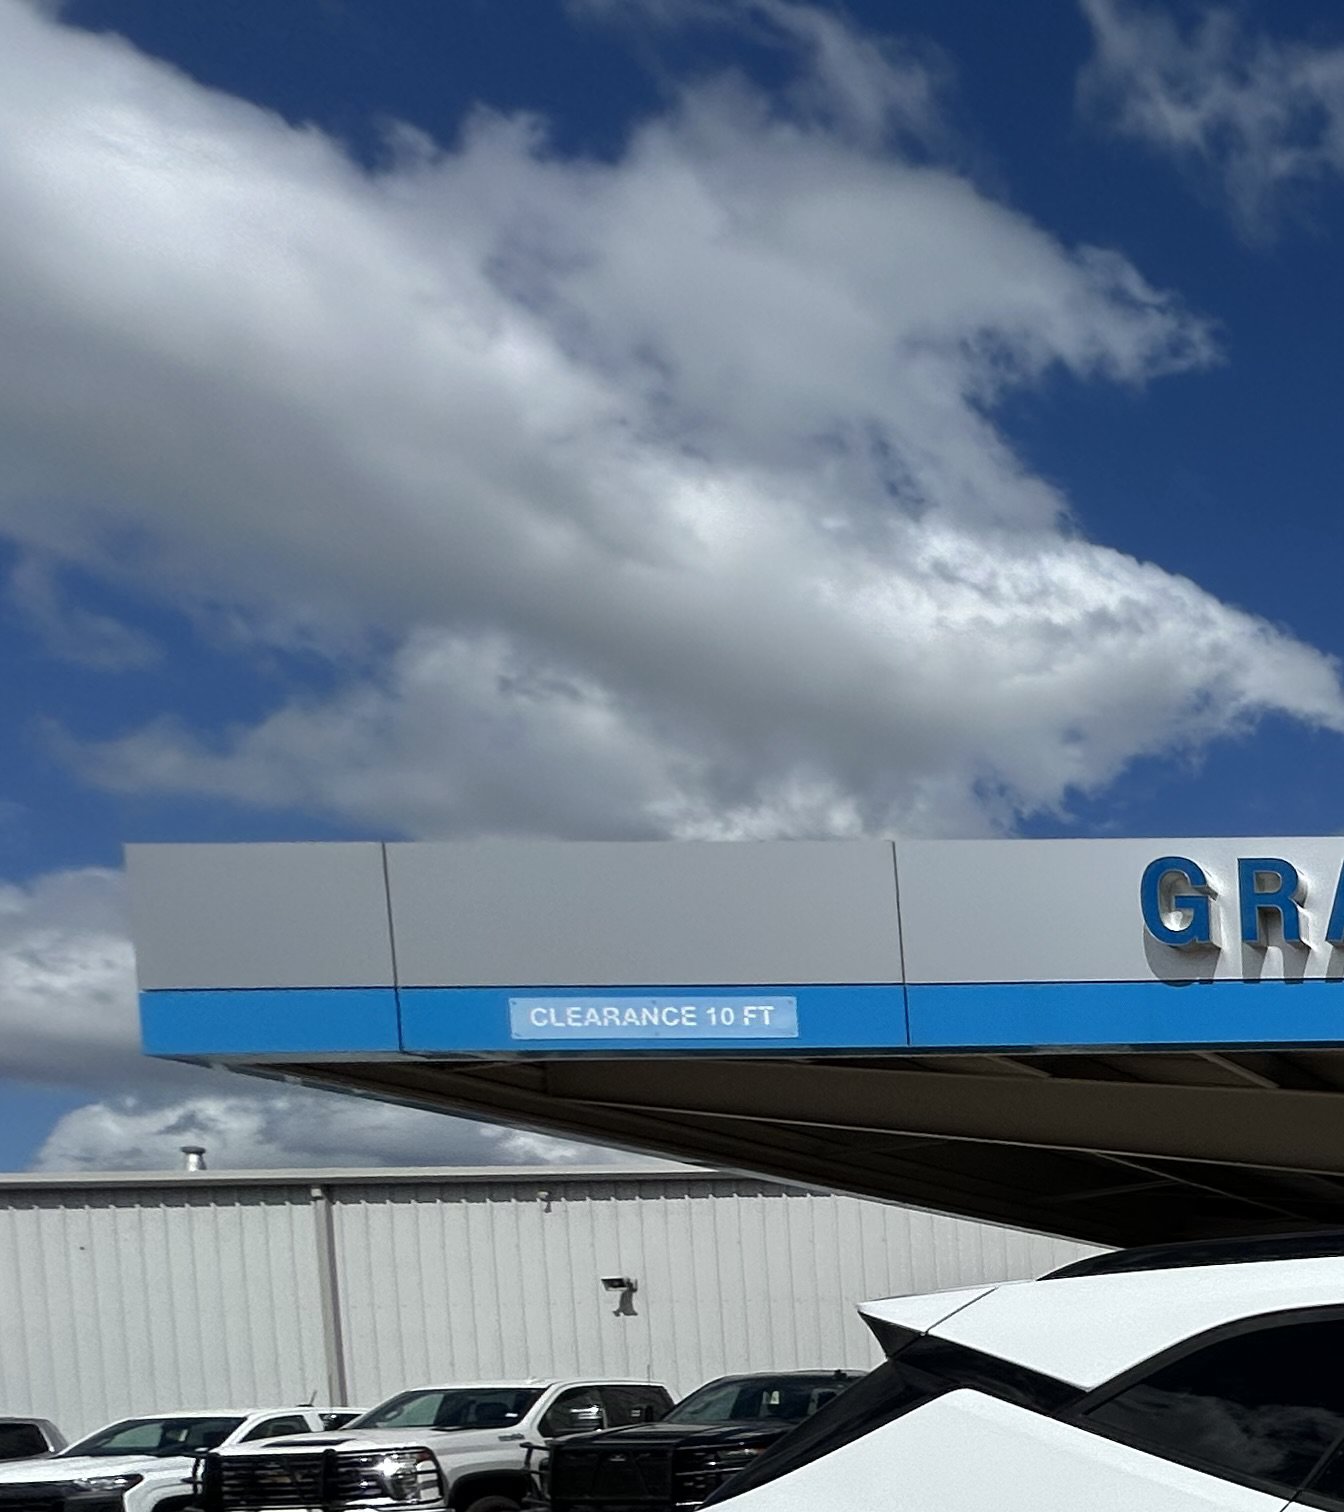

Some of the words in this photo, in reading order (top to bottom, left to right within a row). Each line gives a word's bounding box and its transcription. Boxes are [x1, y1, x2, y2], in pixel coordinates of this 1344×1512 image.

[529, 1006, 698, 1028] CLEARANCE
[706, 1006, 735, 1026] 10
[743, 1005, 775, 1026] FT
